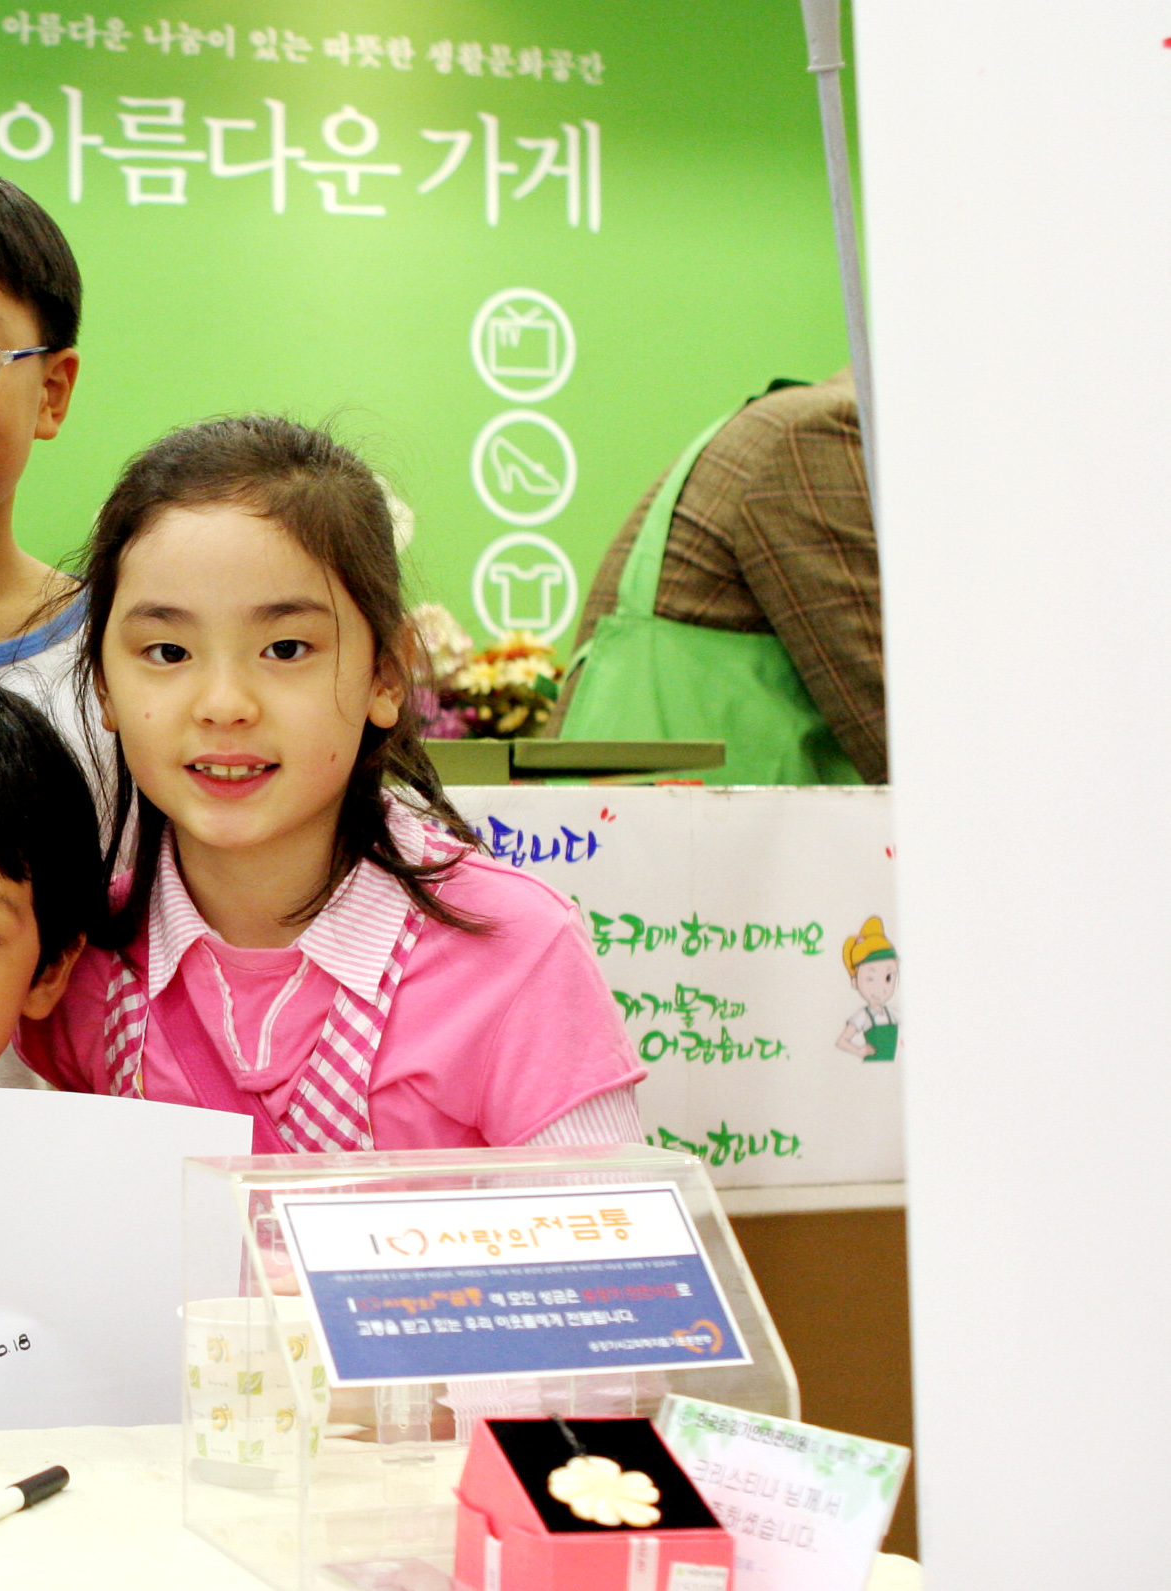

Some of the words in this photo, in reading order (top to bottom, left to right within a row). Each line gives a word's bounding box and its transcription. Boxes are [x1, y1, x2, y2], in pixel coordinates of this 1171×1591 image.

[2, 9, 132, 52] 아름다운
[143, 19, 236, 59] 나눔이
[249, 26, 313, 63] 있는
[322, 31, 415, 71] 따뜻한
[426, 39, 605, 85] 생활문화공간
[417, 111, 601, 234] 가게
